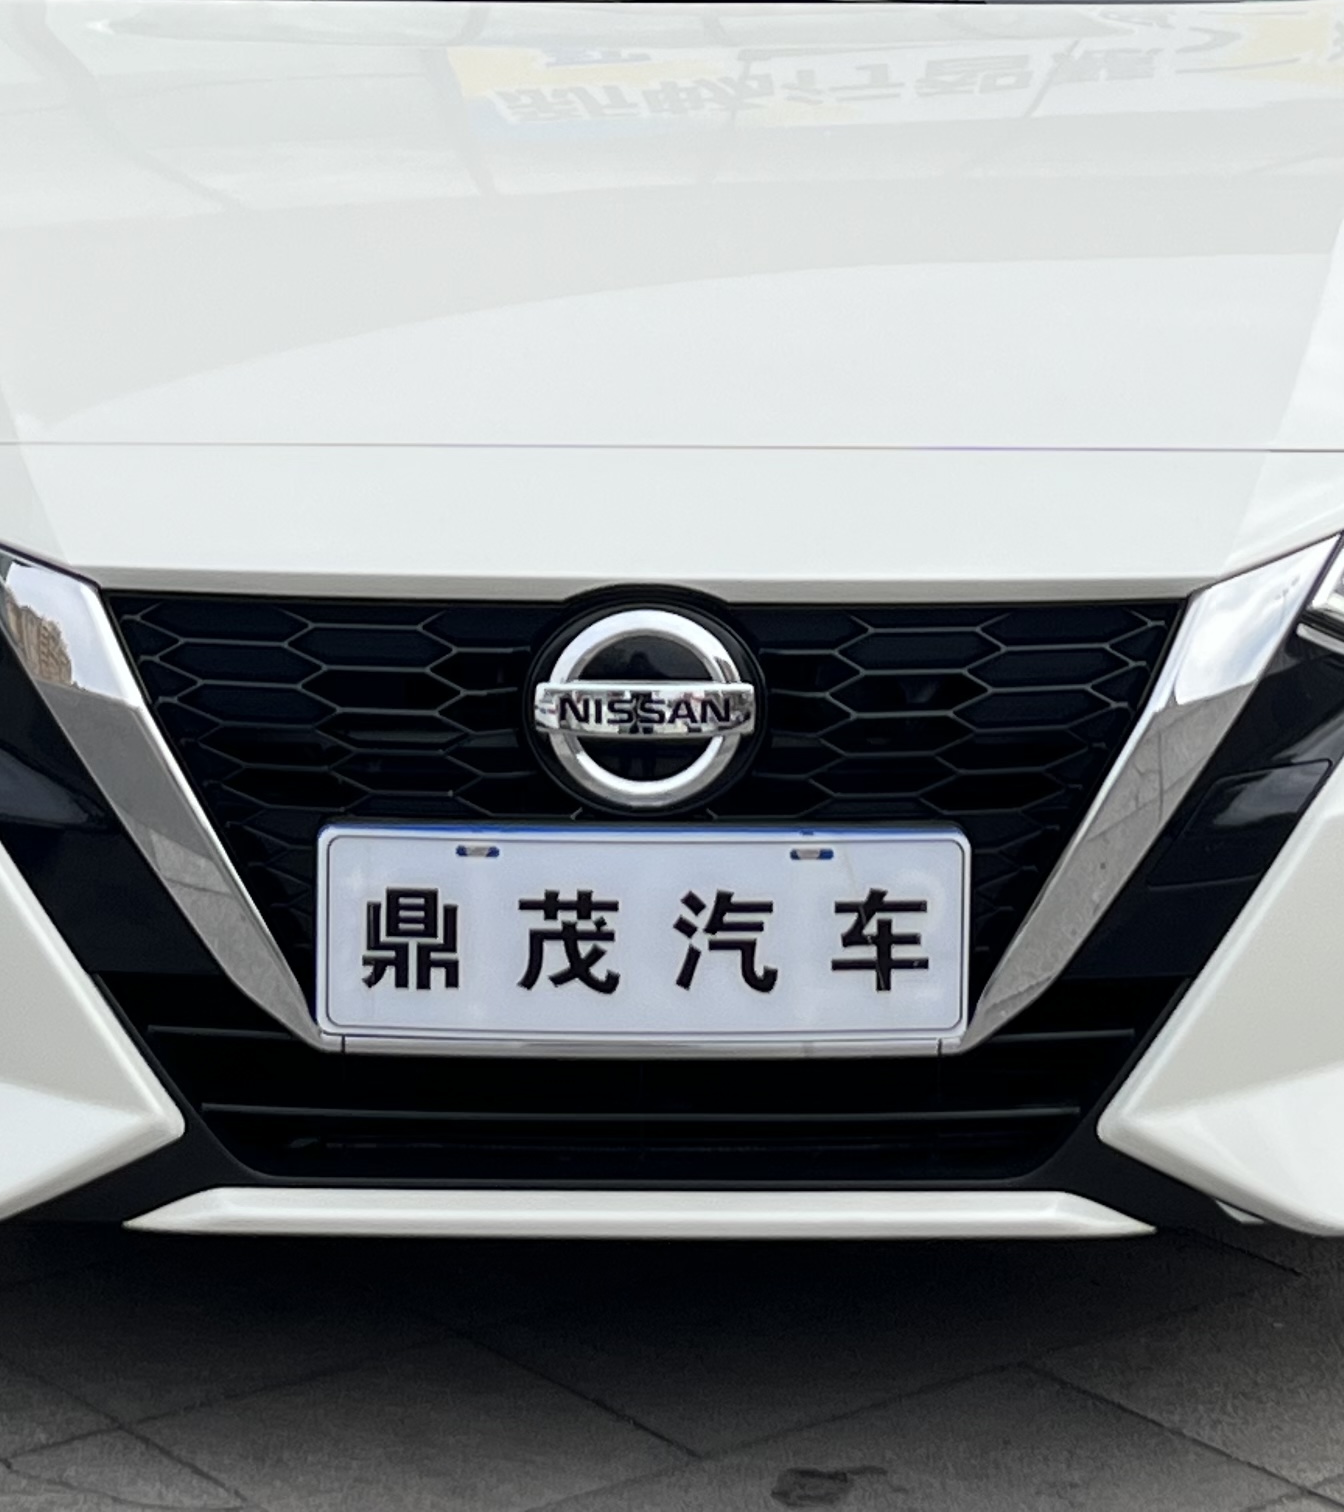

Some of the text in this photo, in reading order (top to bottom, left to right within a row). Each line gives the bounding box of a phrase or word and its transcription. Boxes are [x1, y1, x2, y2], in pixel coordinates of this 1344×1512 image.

[558, 696, 733, 725] NISSAN
[361, 888, 930, 993] 鼎茂汽车
